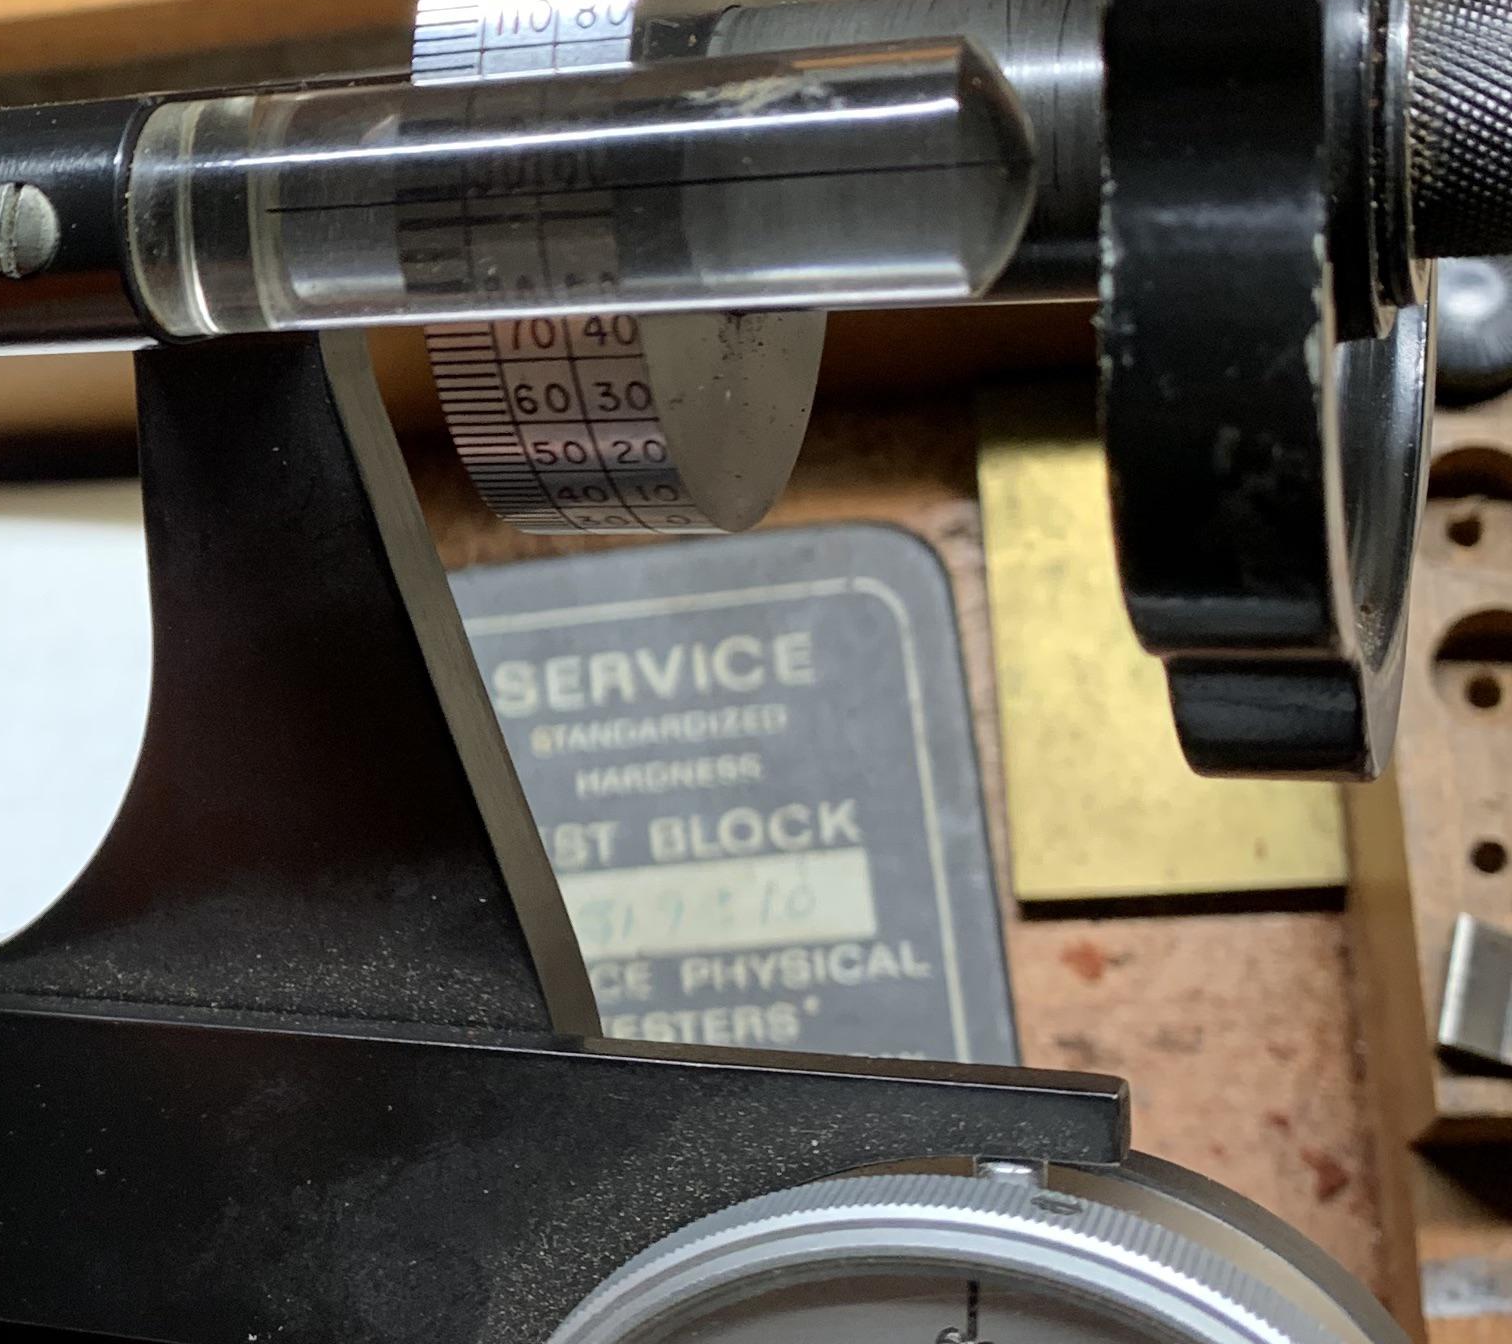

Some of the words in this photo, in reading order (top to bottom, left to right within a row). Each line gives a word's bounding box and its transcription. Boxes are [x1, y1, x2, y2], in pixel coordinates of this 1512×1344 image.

[496, 0, 553, 36] 110
[508, 316, 556, 351] 70
[583, 314, 638, 347] 40
[513, 383, 570, 414] 60
[593, 380, 653, 412] 30
[532, 440, 587, 466] 50
[612, 439, 667, 464] 20
[556, 485, 609, 504] 40
[639, 484, 679, 502] 10
[492, 631, 815, 718] SERVICE
[531, 704, 787, 758] STANDARDIZED
[574, 752, 763, 799] HARDNESS
[648, 798, 863, 863] BLOCK
[680, 939, 930, 997] PHYSICAL
